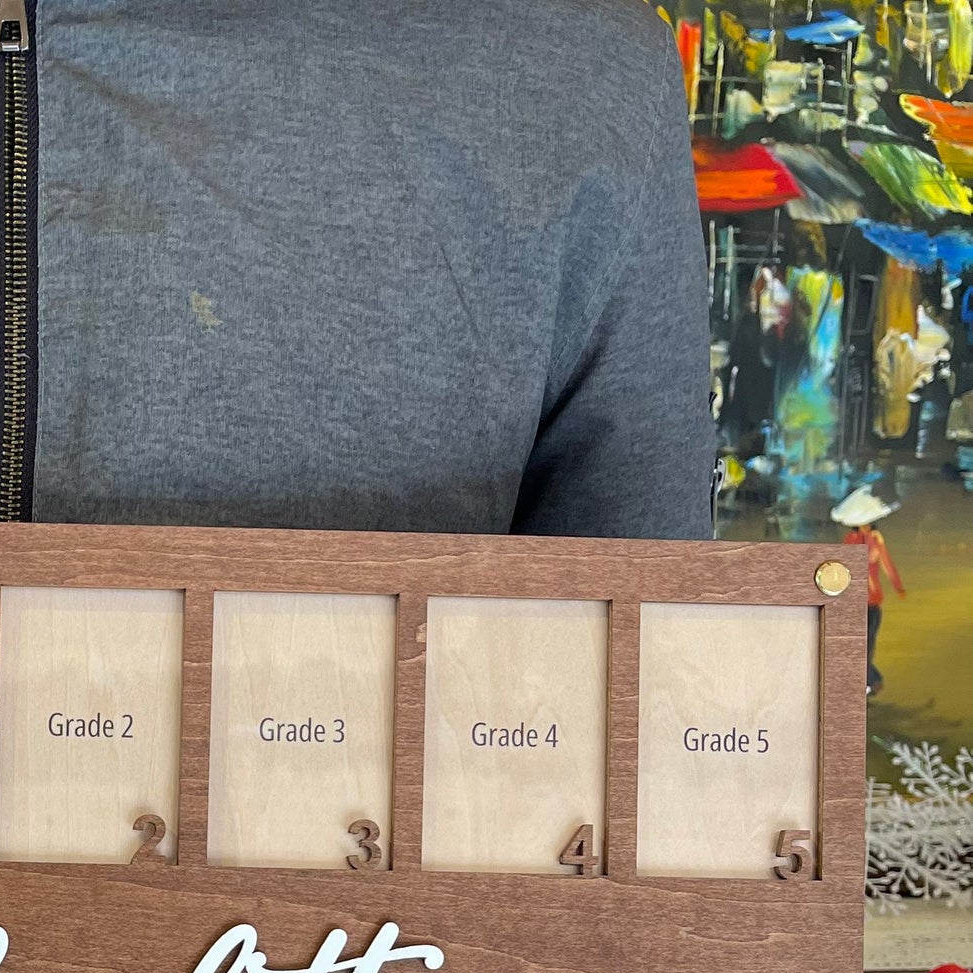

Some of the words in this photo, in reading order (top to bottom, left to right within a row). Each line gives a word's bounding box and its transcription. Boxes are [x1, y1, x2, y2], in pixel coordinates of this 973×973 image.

[48, 712, 114, 739] Grade
[121, 715, 134, 739] 2
[259, 717, 325, 744] Grade
[332, 719, 346, 743] 3
[471, 721, 537, 749] Grade
[544, 724, 559, 749] 4
[683, 727, 749, 753] Grade
[757, 729, 769, 754] 5
[130, 814, 167, 865] 2
[346, 820, 382, 871] 3
[558, 825, 598, 875] 4
[773, 830, 811, 880] 5
